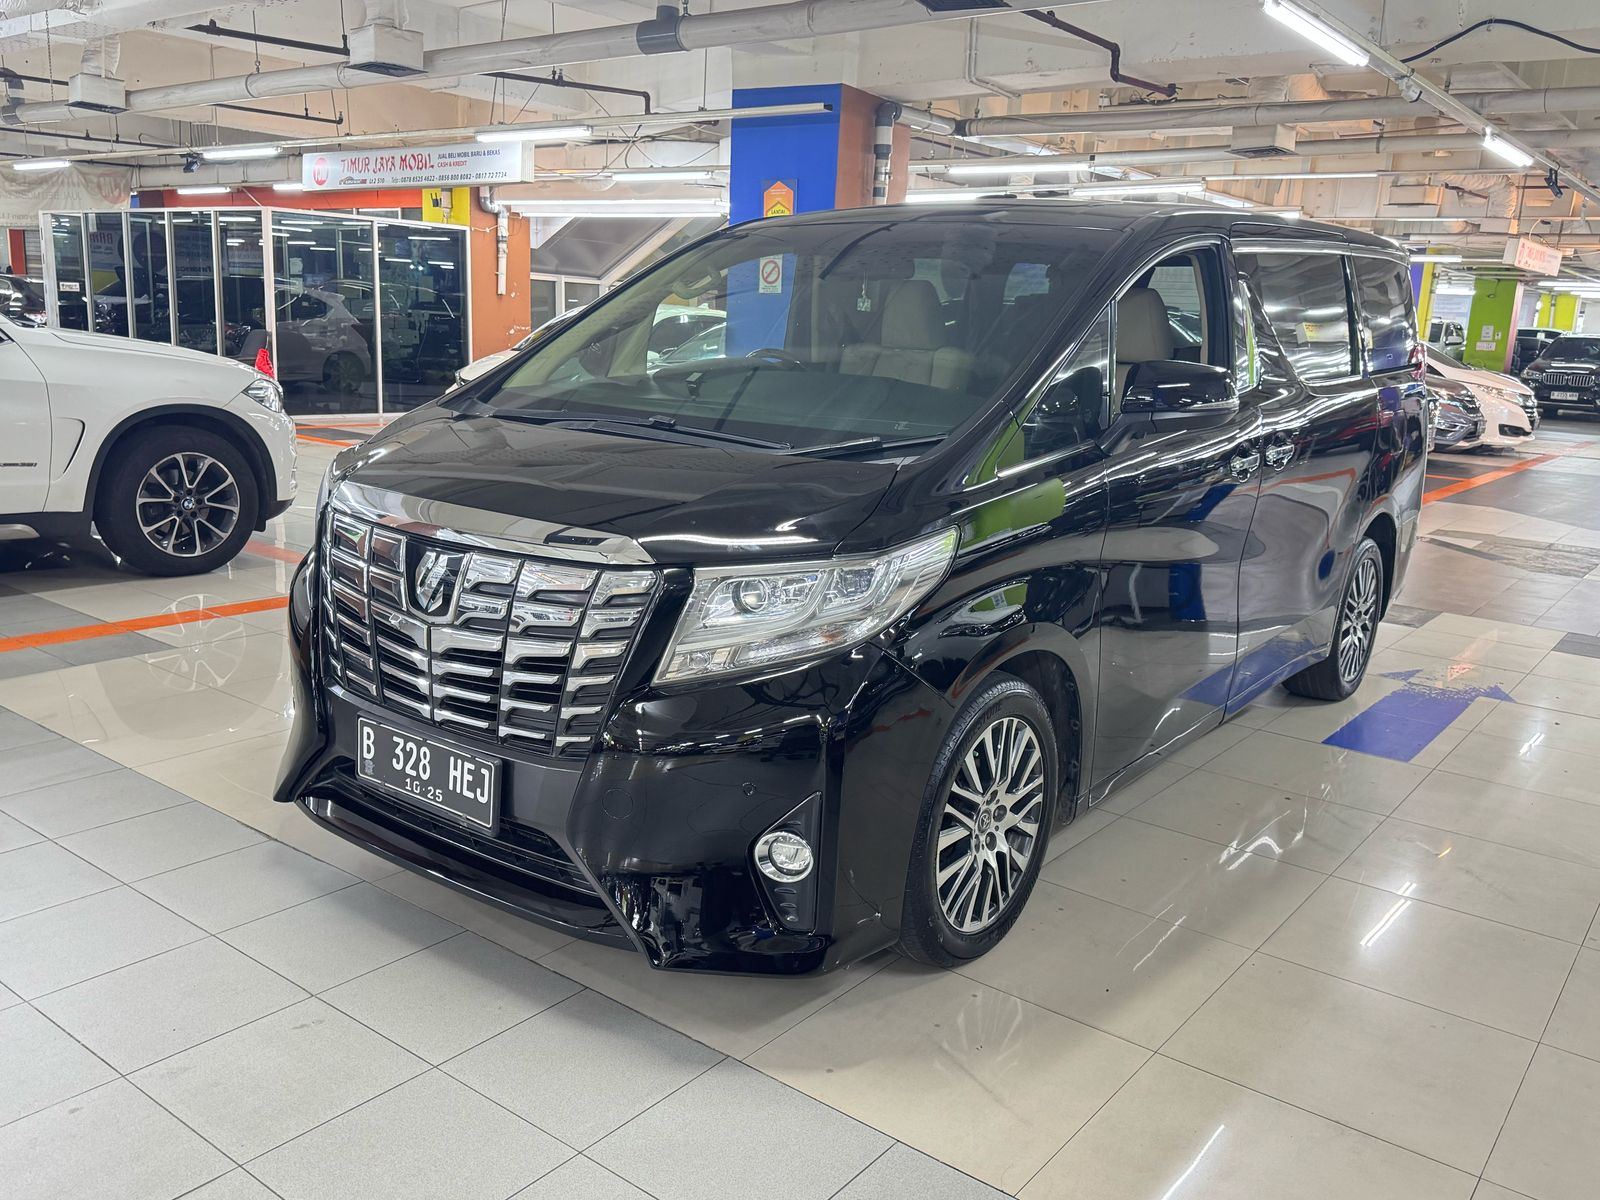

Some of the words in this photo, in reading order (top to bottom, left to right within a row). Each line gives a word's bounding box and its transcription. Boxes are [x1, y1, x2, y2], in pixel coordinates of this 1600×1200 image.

[341, 156, 370, 174] TIMUR
[372, 155, 396, 174] JAYA
[399, 152, 435, 171] MOBIL
[437, 152, 448, 160] JUAL
[362, 726, 375, 760] B
[392, 735, 431, 781] 328
[449, 756, 490, 804] HEJ
